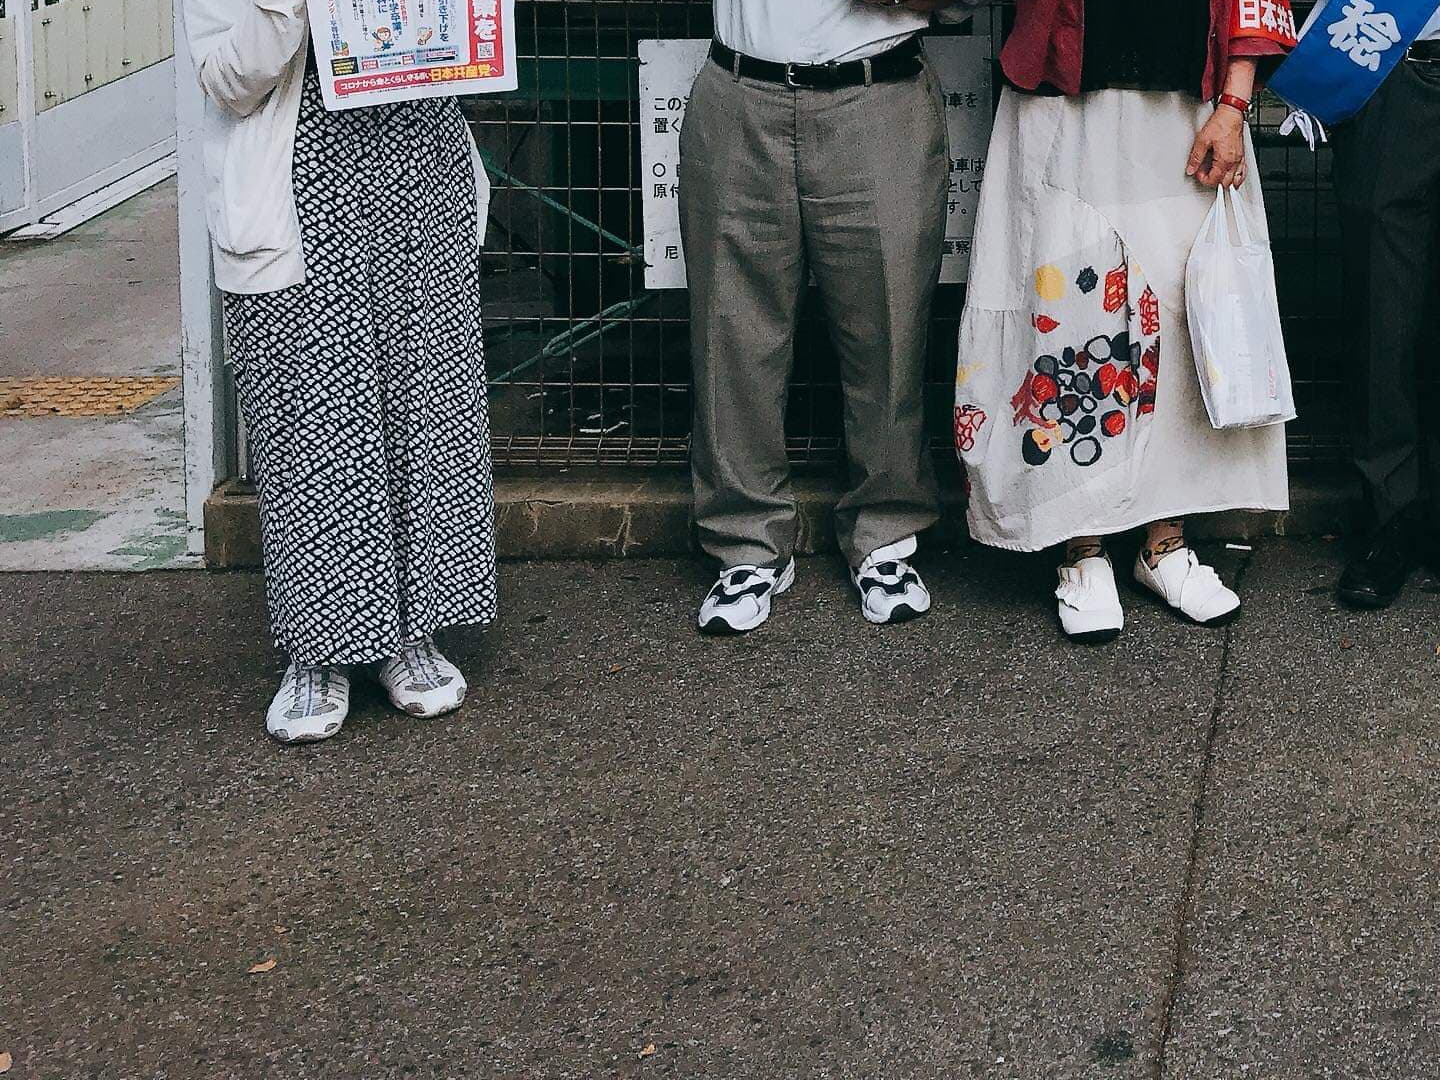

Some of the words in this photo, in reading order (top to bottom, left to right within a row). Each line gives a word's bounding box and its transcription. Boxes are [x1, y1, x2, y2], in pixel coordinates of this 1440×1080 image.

[944, 92, 978, 108] 車を
[653, 117, 680, 134] 置く
[664, 245, 679, 260] 尼
